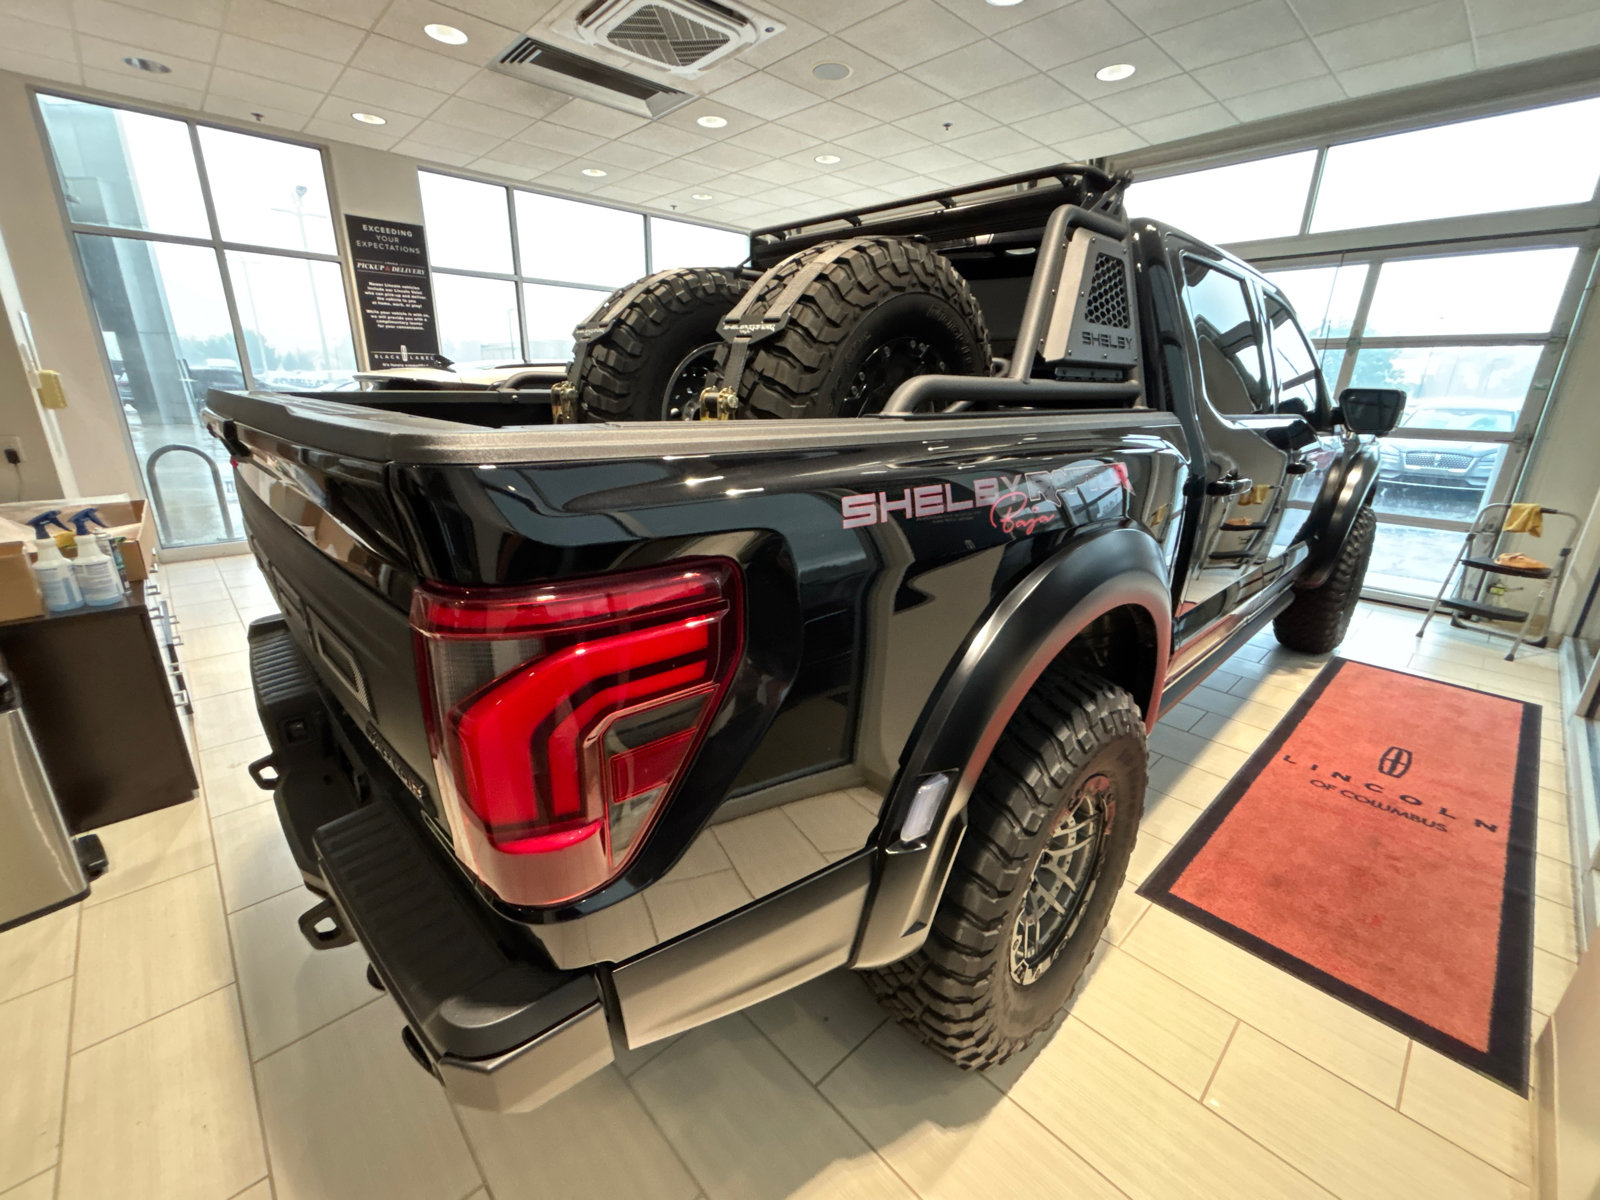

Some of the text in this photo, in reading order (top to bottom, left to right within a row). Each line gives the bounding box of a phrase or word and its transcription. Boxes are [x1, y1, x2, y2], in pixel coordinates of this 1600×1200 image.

[362, 224, 413, 237] EXCEEDING
[376, 235, 399, 243] YOUR
[356, 240, 421, 254] EXPECTATIONS
[357, 262, 385, 271] PICKUP
[392, 266, 425, 275] DELIVERY
[1082, 331, 1132, 350] SHELBY
[842, 474, 1022, 529] SHELBY
[990, 491, 1055, 535] Baja
[1283, 755, 1498, 832] LINCOLN
[1310, 779, 1448, 832] OF COLUMBUS
